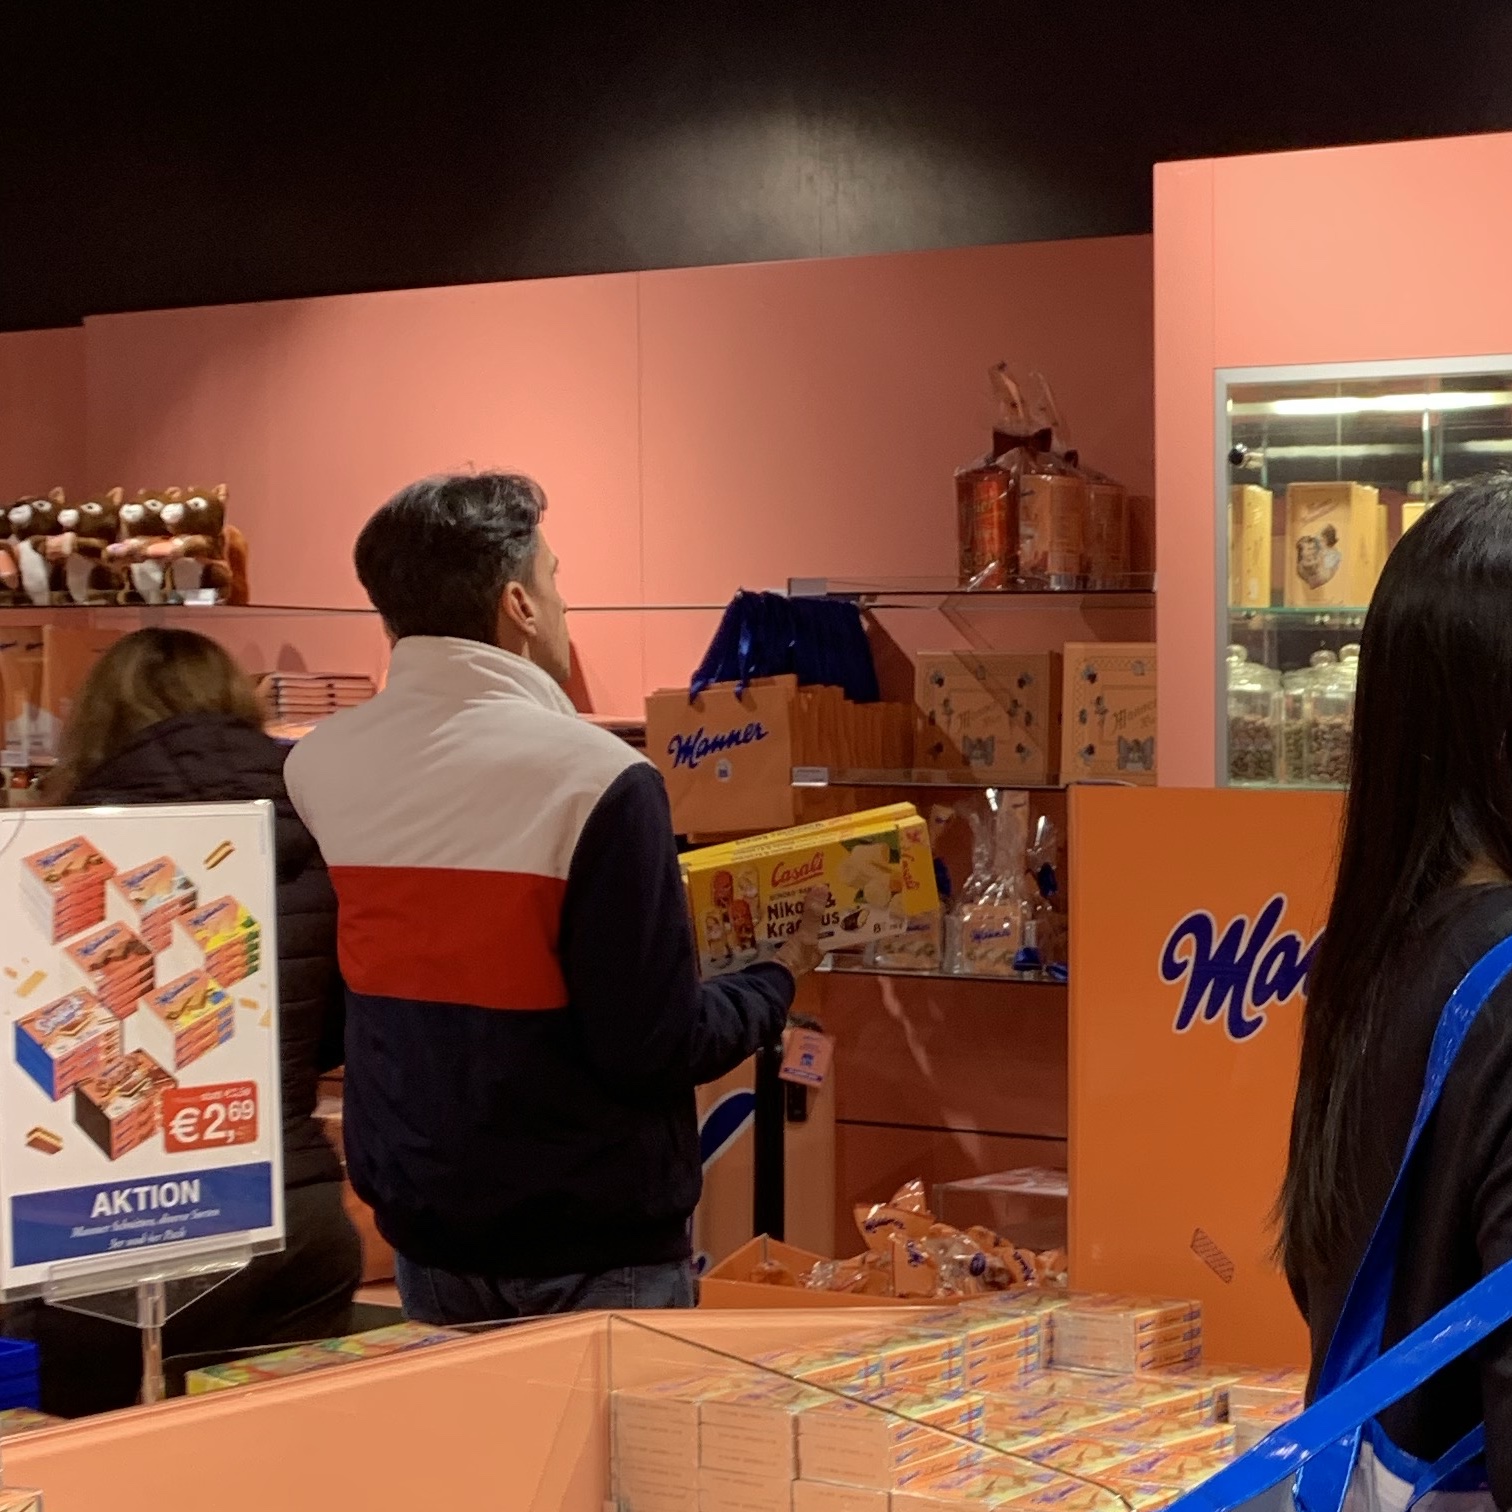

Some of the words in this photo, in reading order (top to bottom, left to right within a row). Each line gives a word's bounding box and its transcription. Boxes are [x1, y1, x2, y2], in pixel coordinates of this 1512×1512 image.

[666, 722, 769, 769] Manner
[771, 851, 824, 888] Casali
[767, 901, 805, 921] Niko
[767, 911, 840, 938] Kraus
[90, 1178, 200, 1218] AKTION
